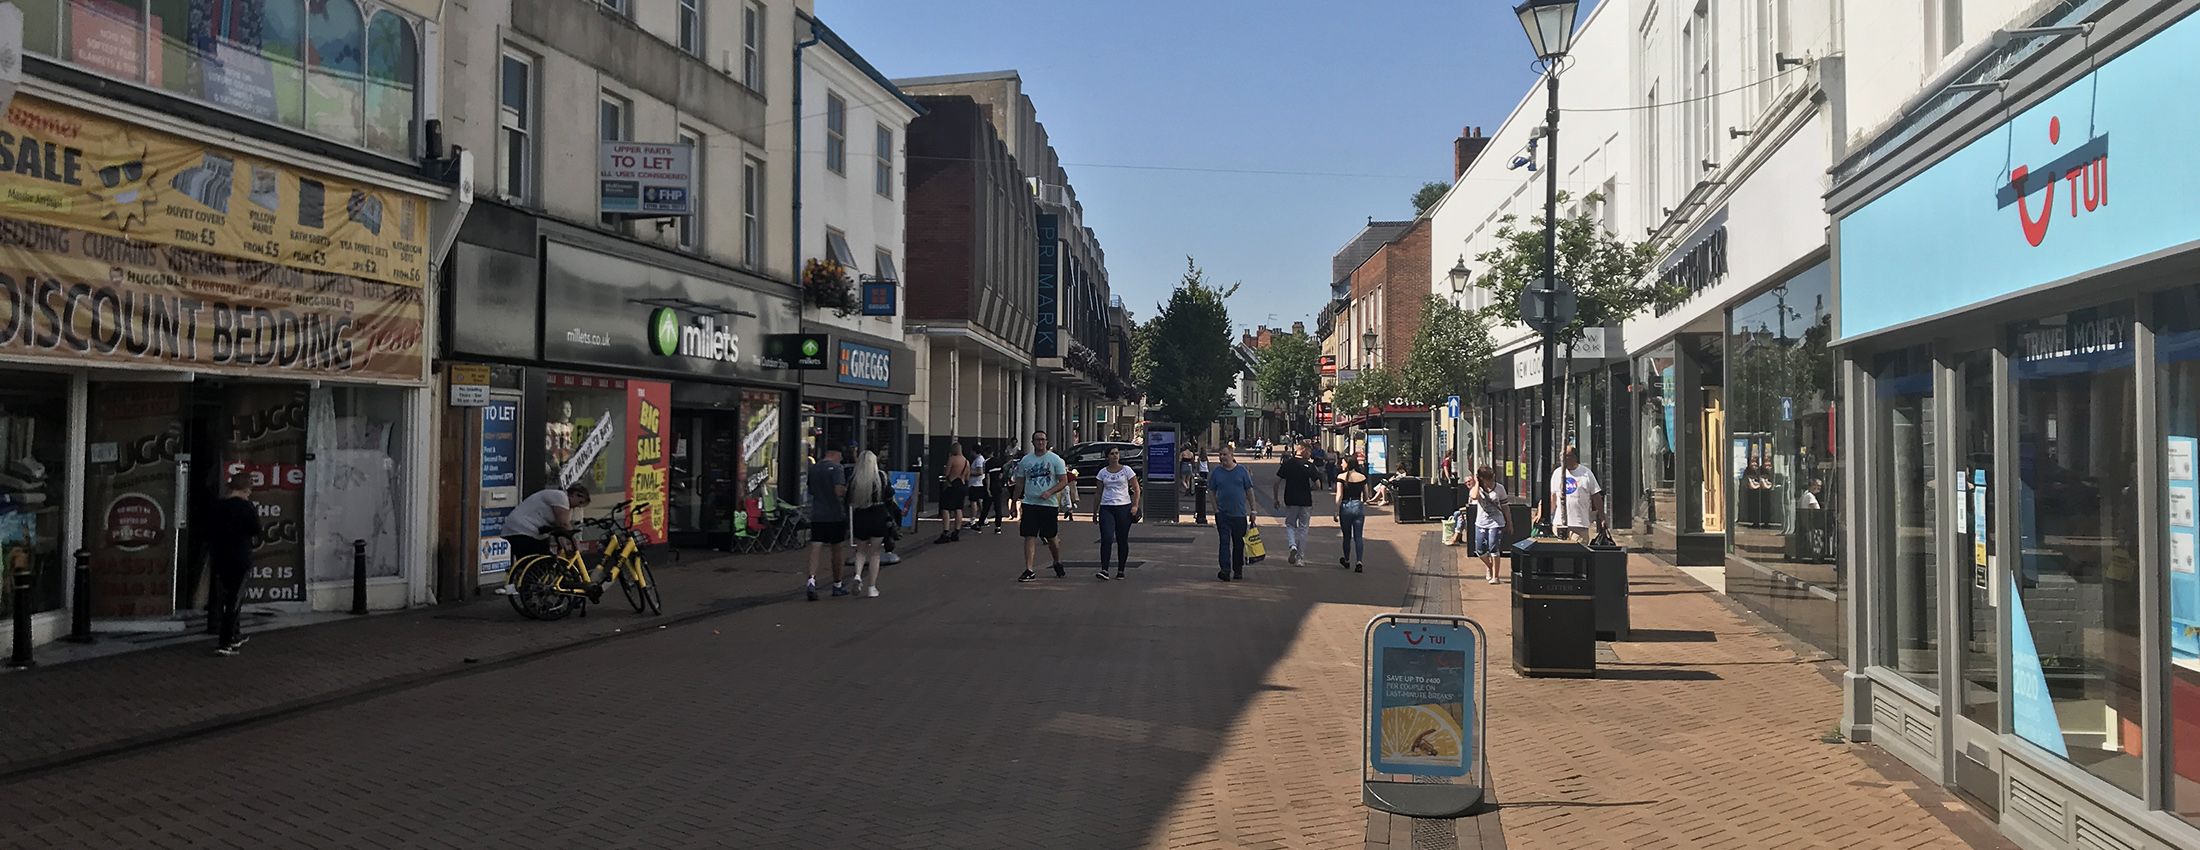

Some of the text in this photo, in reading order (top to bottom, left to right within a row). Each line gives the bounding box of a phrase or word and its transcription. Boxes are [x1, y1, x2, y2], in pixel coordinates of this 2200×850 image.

[0, 131, 83, 186] SALE
[611, 155, 674, 169] TO LET
[659, 190, 683, 200] FHP
[2065, 154, 2109, 218] TUI
[195, 210, 226, 226] COVERS
[0, 219, 70, 253] EDDING
[82, 231, 157, 267] CURTAINS
[175, 228, 216, 246] FROM £5
[265, 240, 280, 258] £5
[313, 249, 327, 267] £3
[365, 258, 377, 274] £2
[1038, 225, 1056, 347] PRIMARK
[0, 271, 206, 361] DISCOUNT
[212, 301, 354, 373] BEDDING
[566, 327, 612, 347] millets.co.uk
[682, 315, 739, 364] millets
[2023, 317, 2126, 362] TRAVEL MONEY
[850, 348, 890, 383] GREGGS
[1388, 397, 1424, 408] COA
[484, 405, 516, 421] TO LET
[639, 400, 660, 434] BIG
[637, 437, 661, 463] SALE
[636, 472, 660, 491] FINAL
[492, 541, 508, 557] FHP
[1429, 635, 1446, 645] TUI
[1400, 684, 1425, 692] COUPLE
